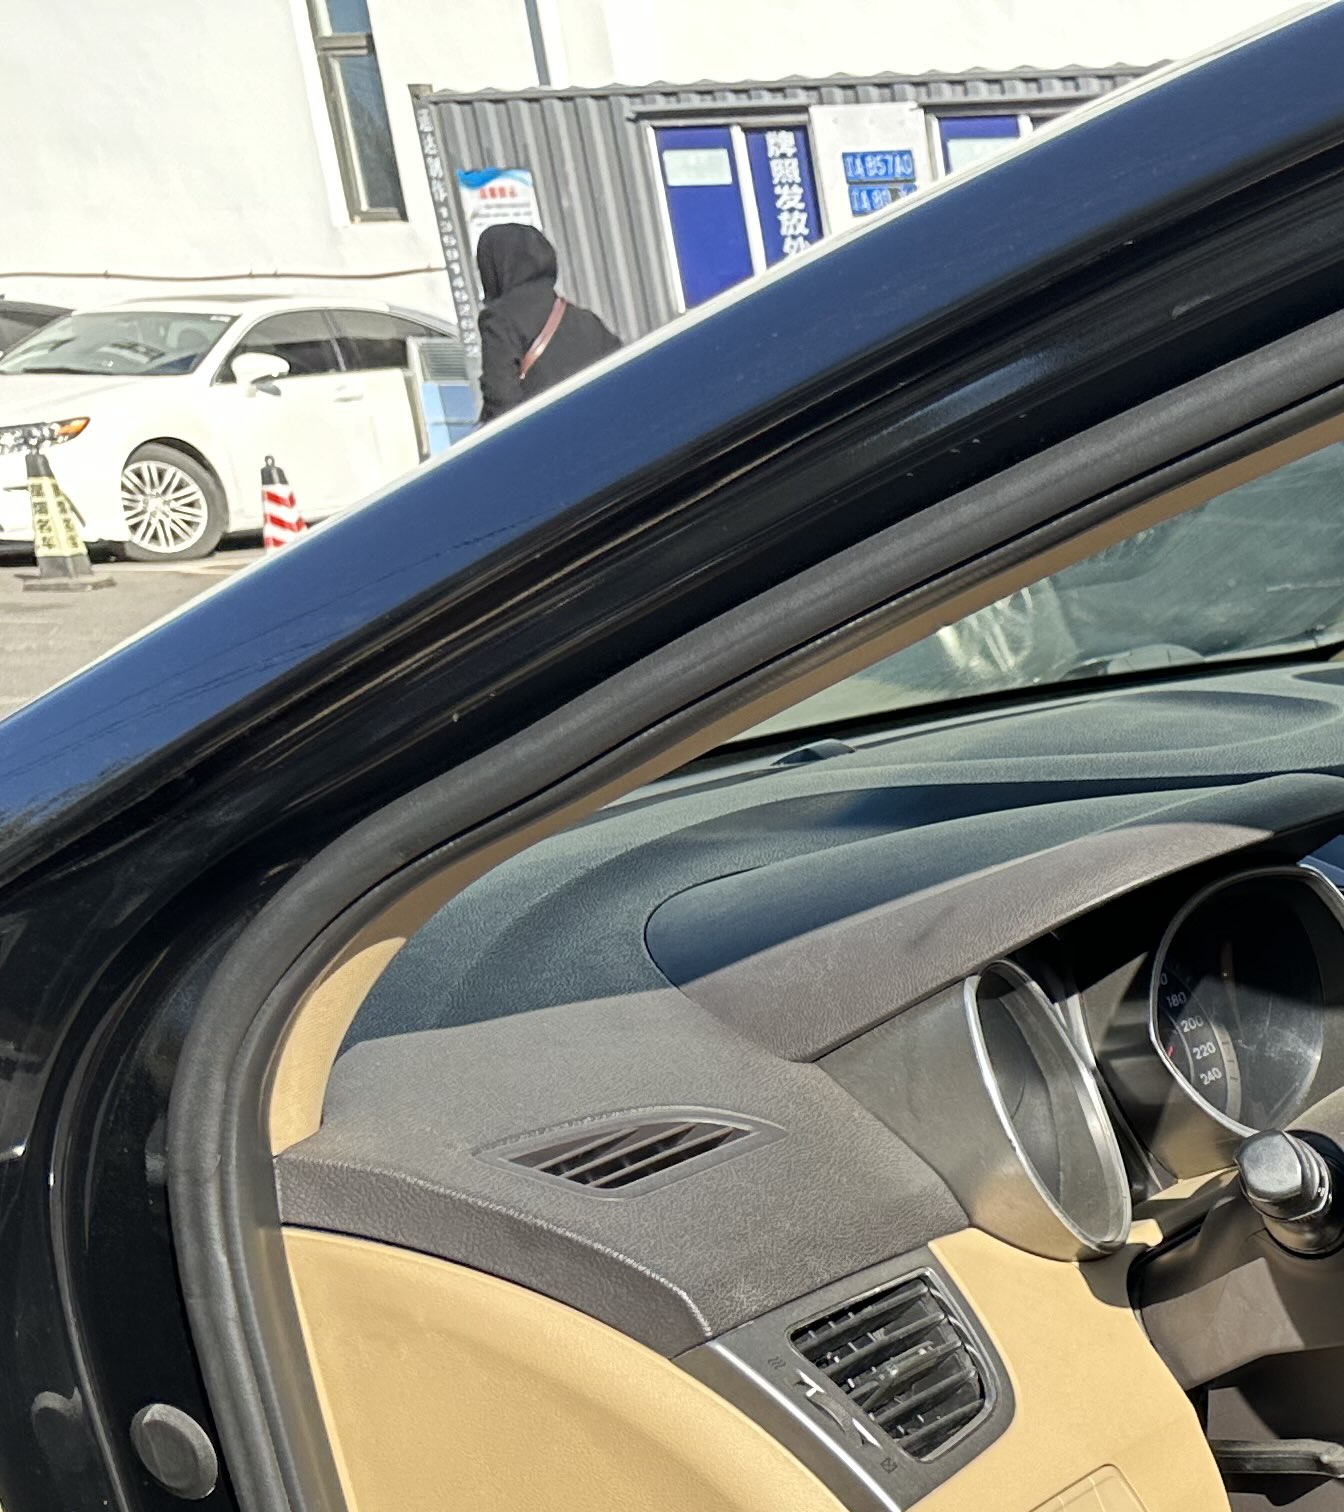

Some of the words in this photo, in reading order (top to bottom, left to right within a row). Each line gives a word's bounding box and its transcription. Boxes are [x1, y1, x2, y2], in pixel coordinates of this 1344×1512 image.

[1165, 991, 1187, 1008] 180
[1180, 1015, 1204, 1033] 200
[1192, 1041, 1216, 1060] 220
[1199, 1067, 1222, 1086] 240
